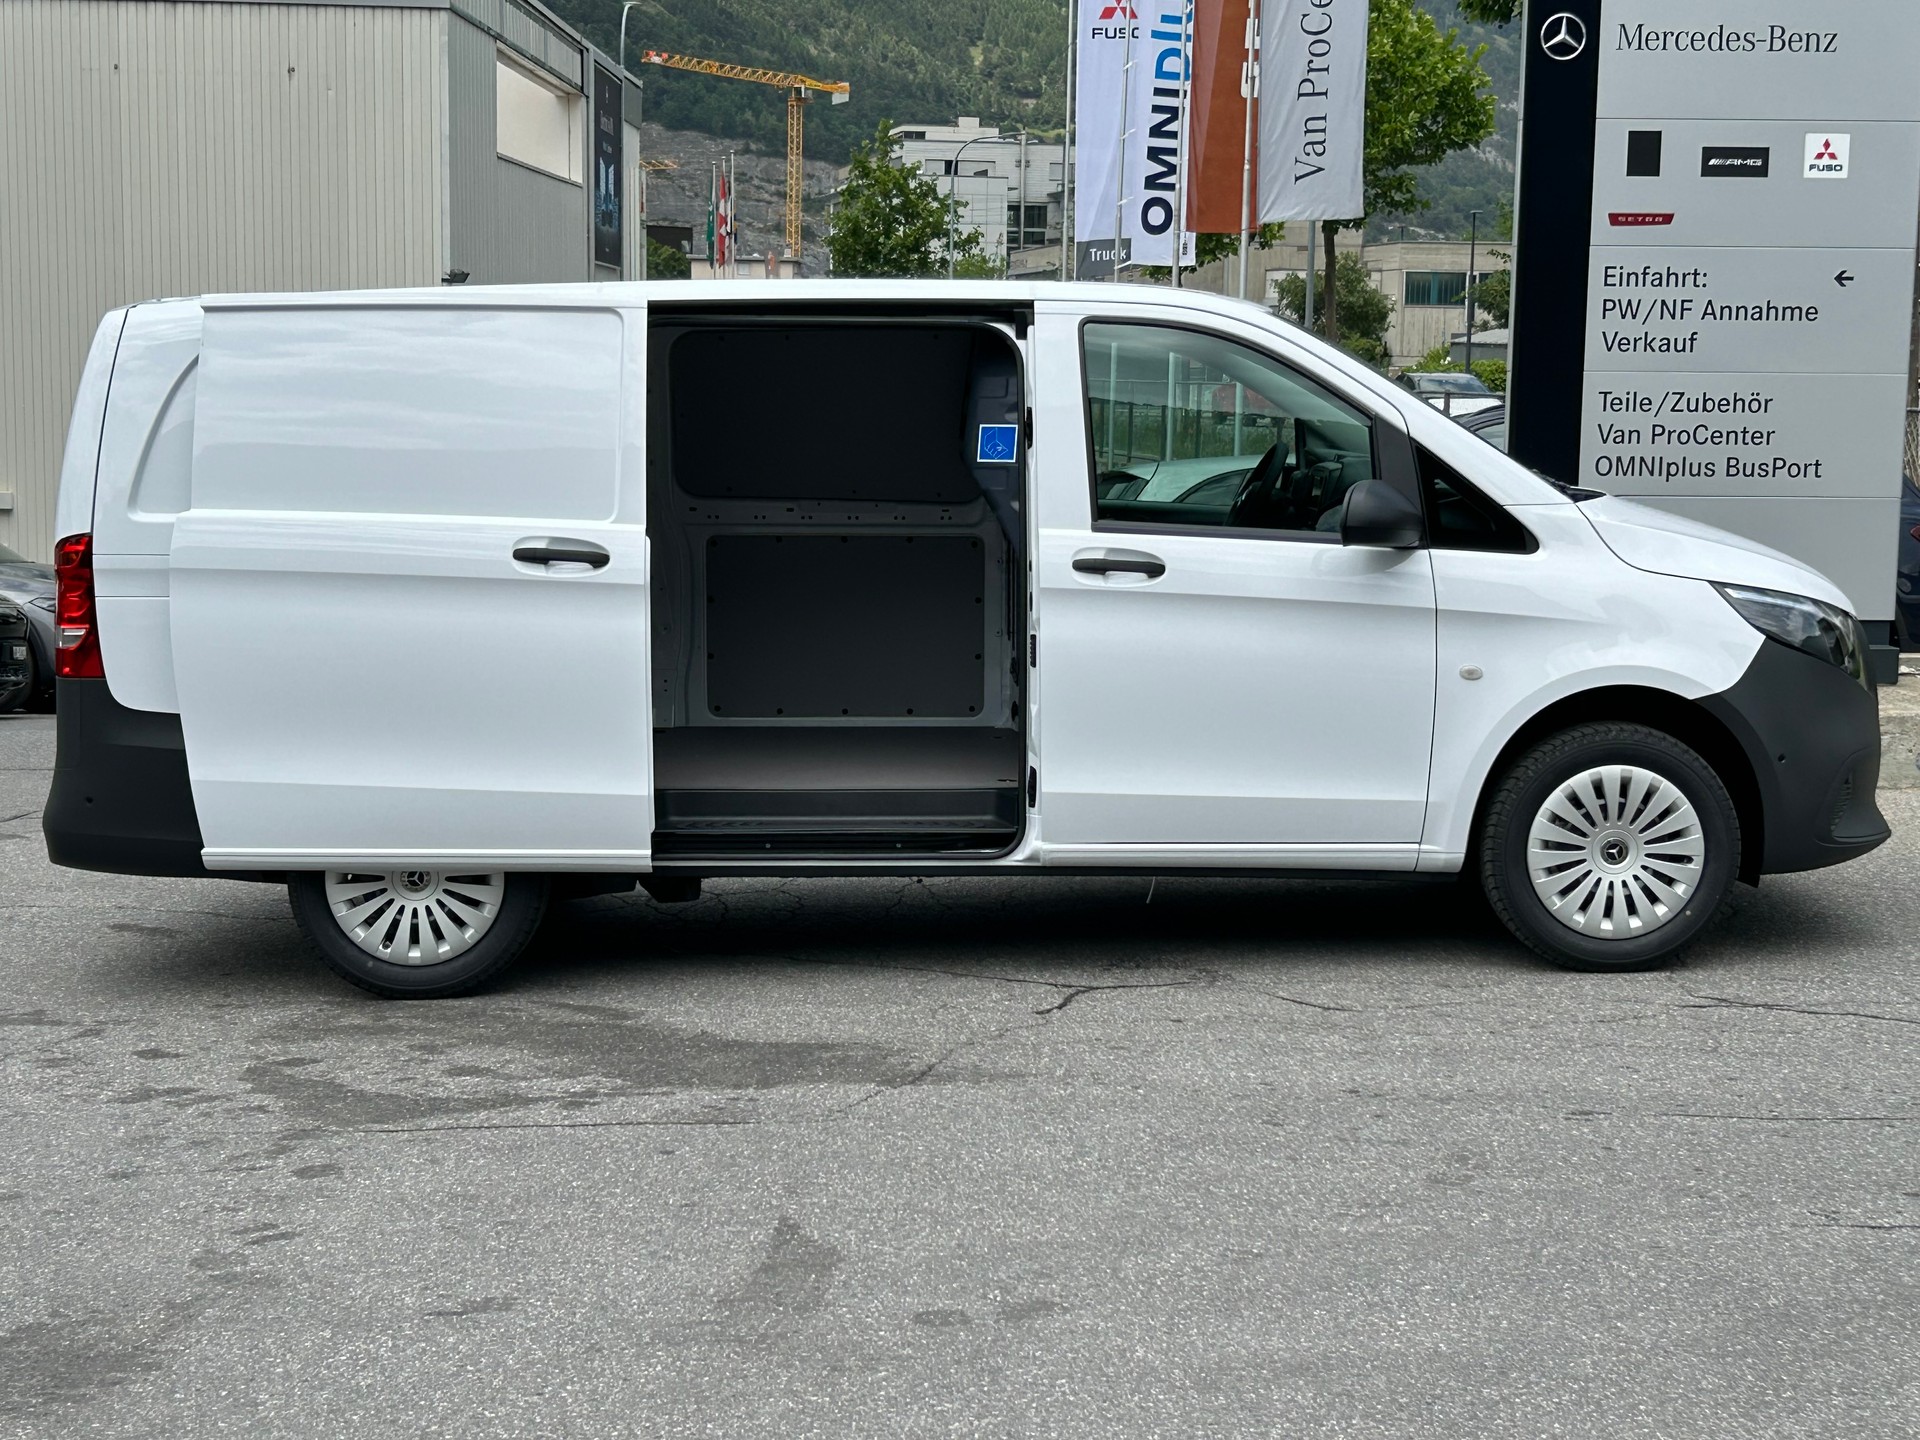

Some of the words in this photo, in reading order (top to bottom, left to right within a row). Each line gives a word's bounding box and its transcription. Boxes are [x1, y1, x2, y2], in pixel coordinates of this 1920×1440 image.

[1615, 23, 1838, 53] Mercedes-Benz
[1294, 113, 1328, 185] Van
[1725, 158, 1763, 166] AMG
[1808, 163, 1843, 172] FUSO
[1603, 265, 1708, 288] Einfahrt:
[1601, 298, 1694, 326] PW/NF
[1700, 300, 1819, 322] Annahme
[1601, 331, 1699, 353] Verkauf
[1598, 391, 1774, 418] Teile/Zubehör
[1597, 423, 1642, 445] Van
[1650, 424, 1776, 446] ProCenter
[1595, 455, 1716, 483] OMNIplus
[1725, 457, 1823, 479] BusPort
